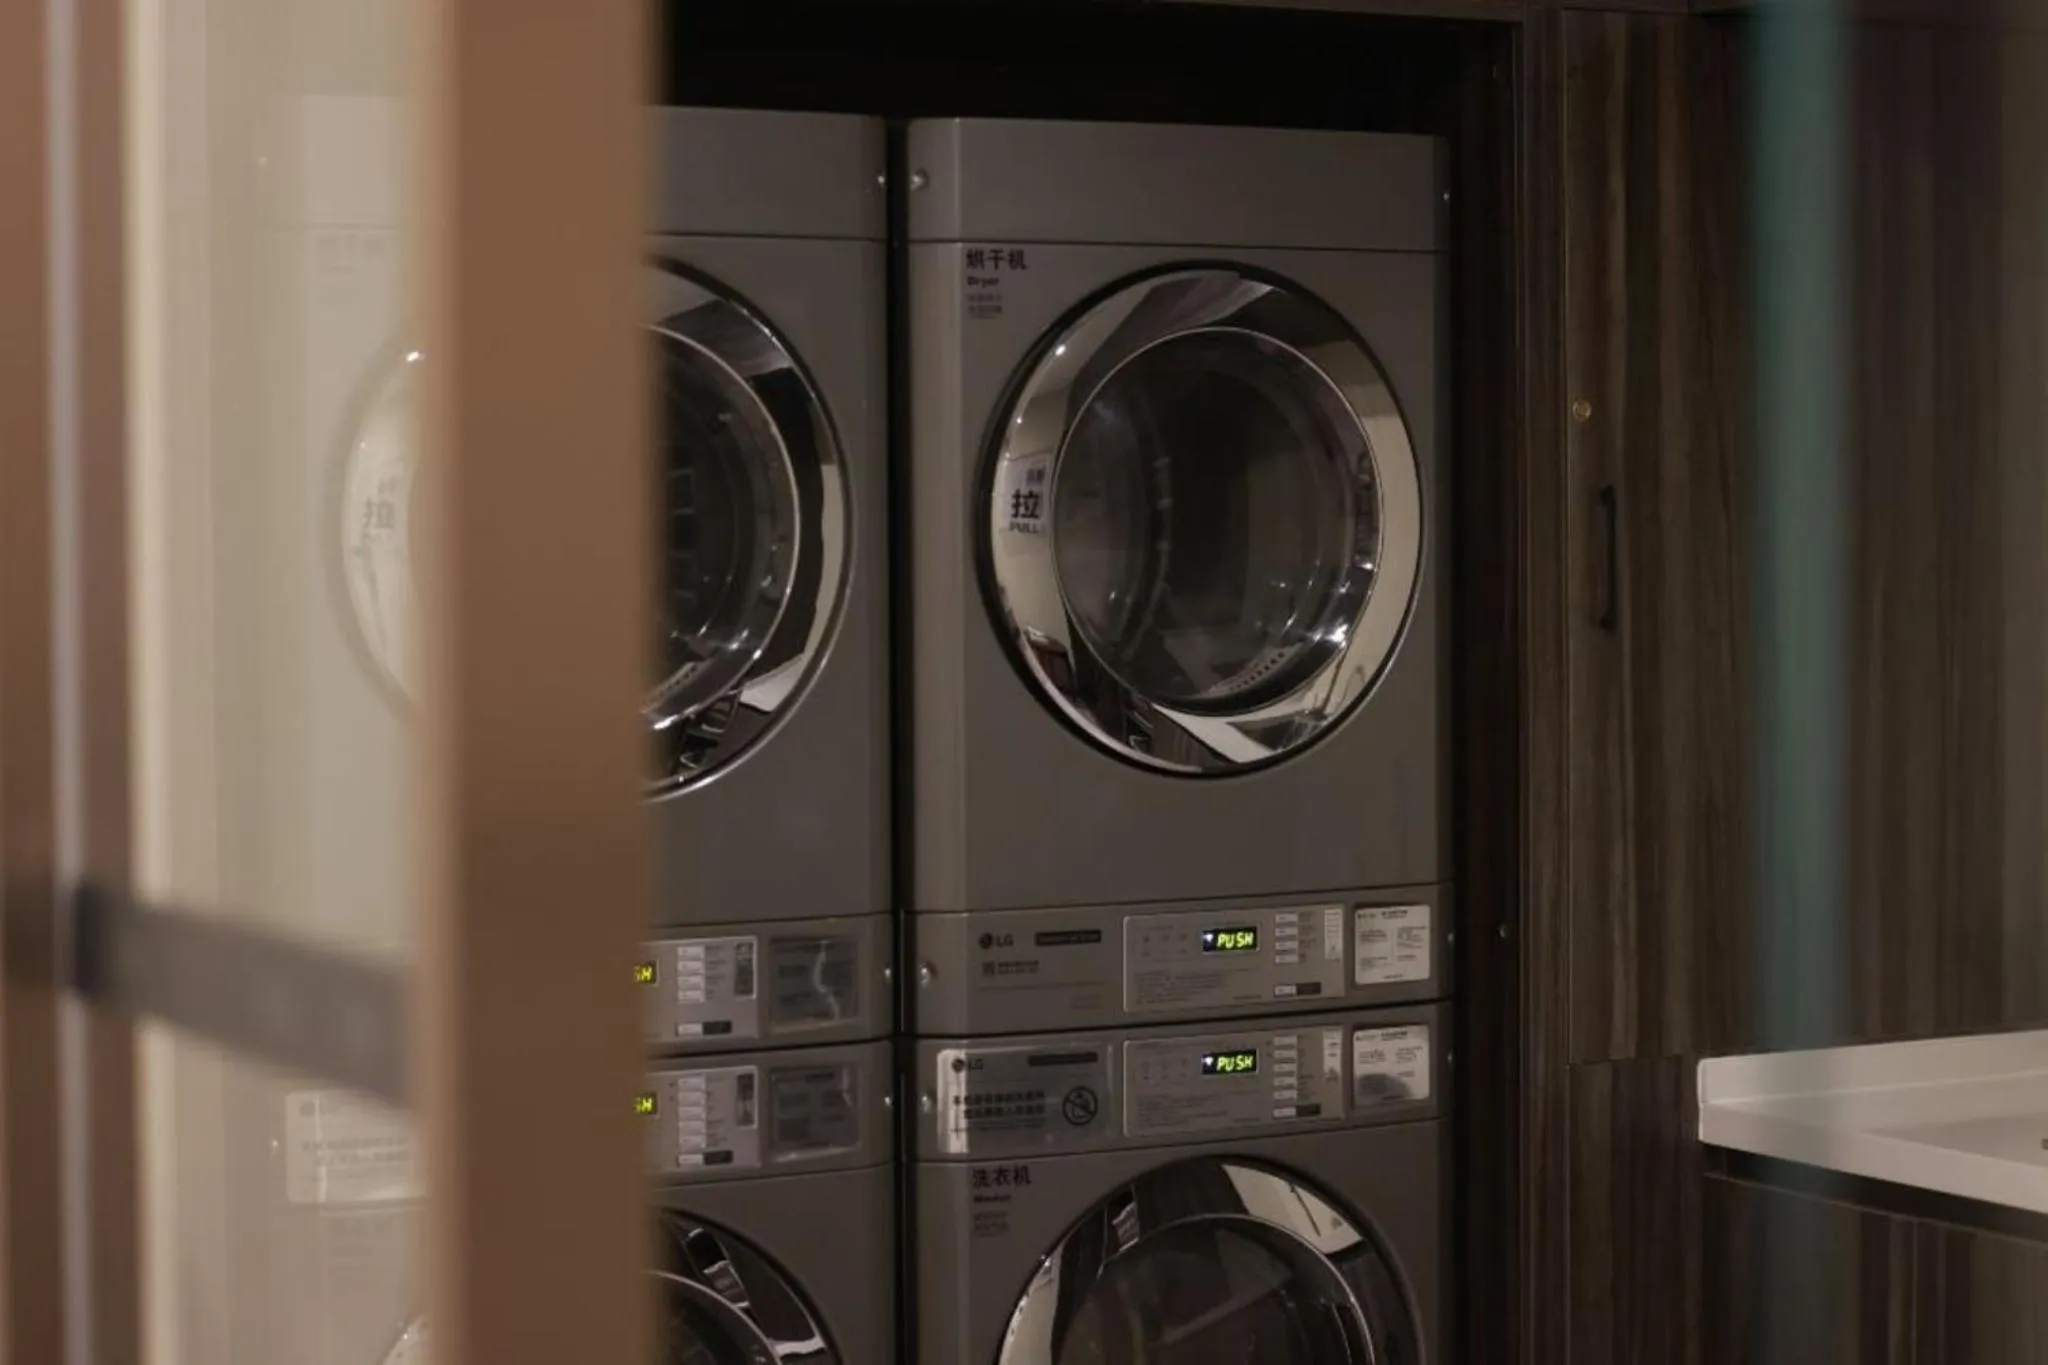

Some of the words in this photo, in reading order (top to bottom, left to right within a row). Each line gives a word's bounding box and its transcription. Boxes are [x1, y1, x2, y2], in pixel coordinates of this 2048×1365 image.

[966, 249, 1027, 270] 烘干机
[1011, 491, 1039, 518] 拉
[1217, 932, 1253, 948] PUSH
[1217, 1056, 1253, 1071] PUSH
[973, 1166, 1031, 1188] 洗衣机
